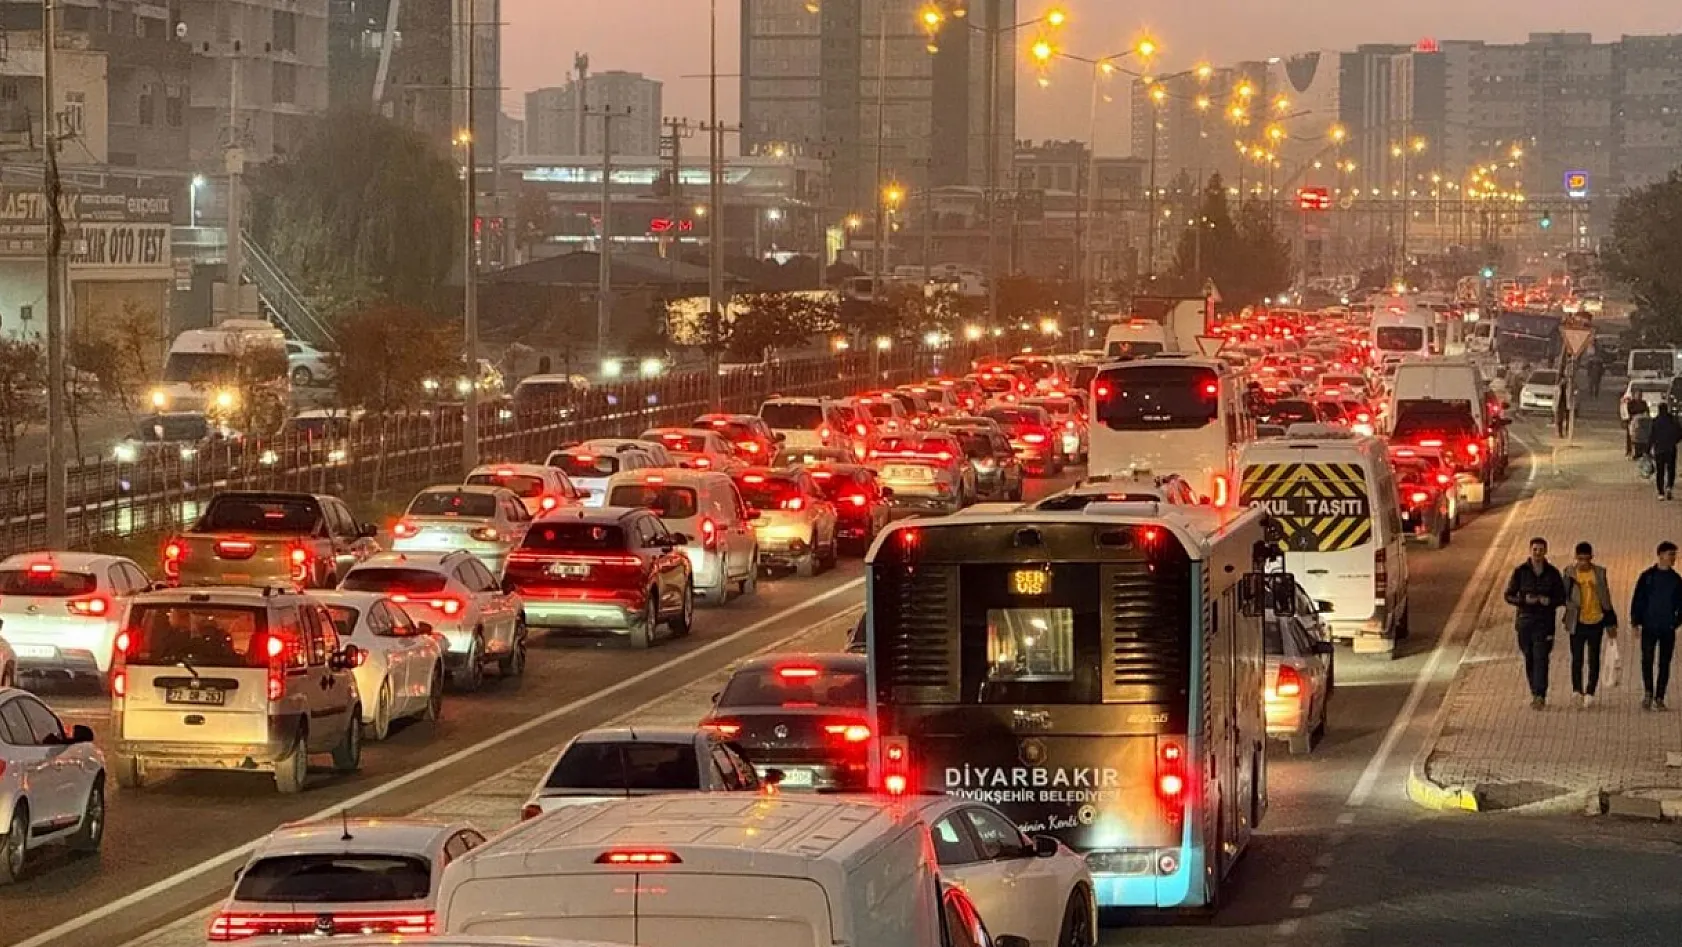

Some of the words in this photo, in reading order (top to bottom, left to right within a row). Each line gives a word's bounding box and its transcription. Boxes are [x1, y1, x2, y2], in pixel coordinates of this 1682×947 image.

[110, 227, 134, 264] OTO
[138, 228, 166, 264] TEST
[945, 762, 1119, 787] DİYARBAKIR
